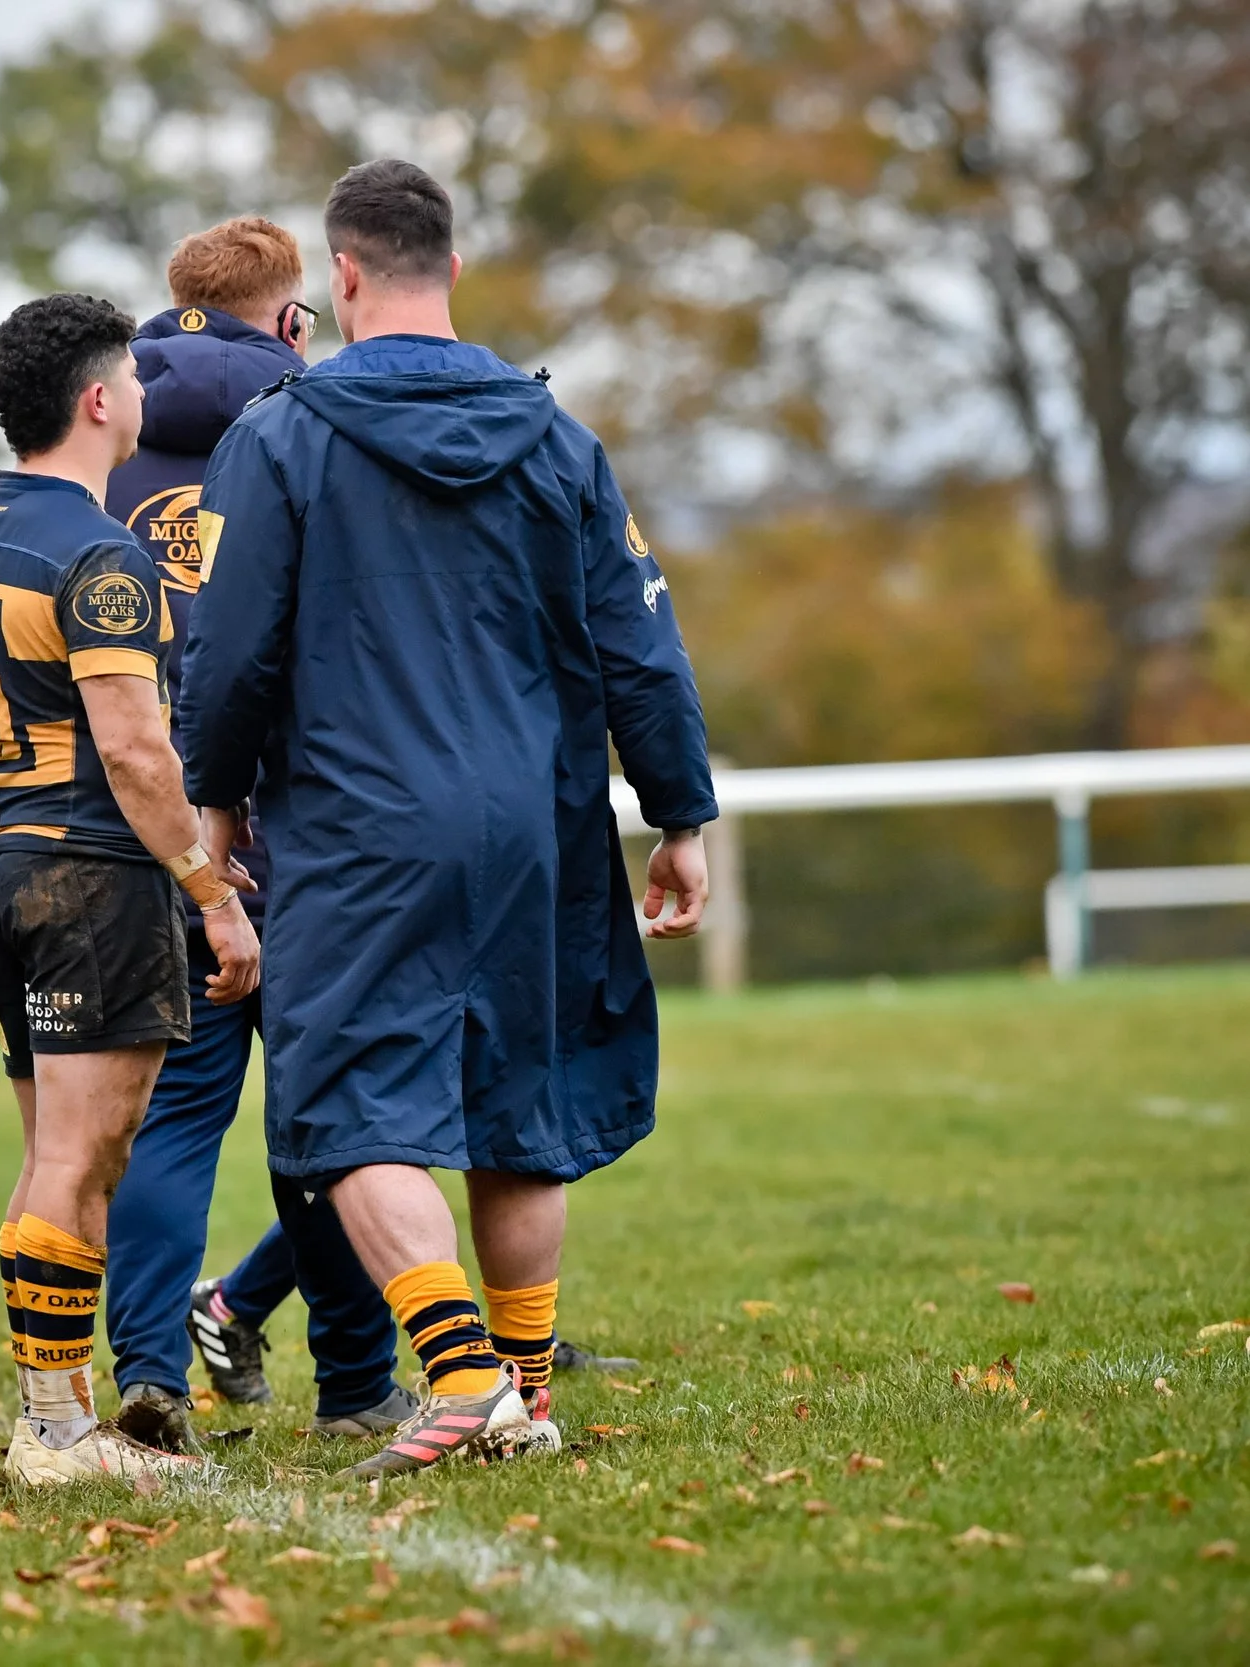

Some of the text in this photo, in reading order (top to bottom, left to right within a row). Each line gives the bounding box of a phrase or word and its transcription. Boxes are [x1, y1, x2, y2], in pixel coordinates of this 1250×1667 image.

[88, 594, 142, 607] MIGHTY
[98, 605, 136, 617] OAKS
[28, 1290, 41, 1304] 7
